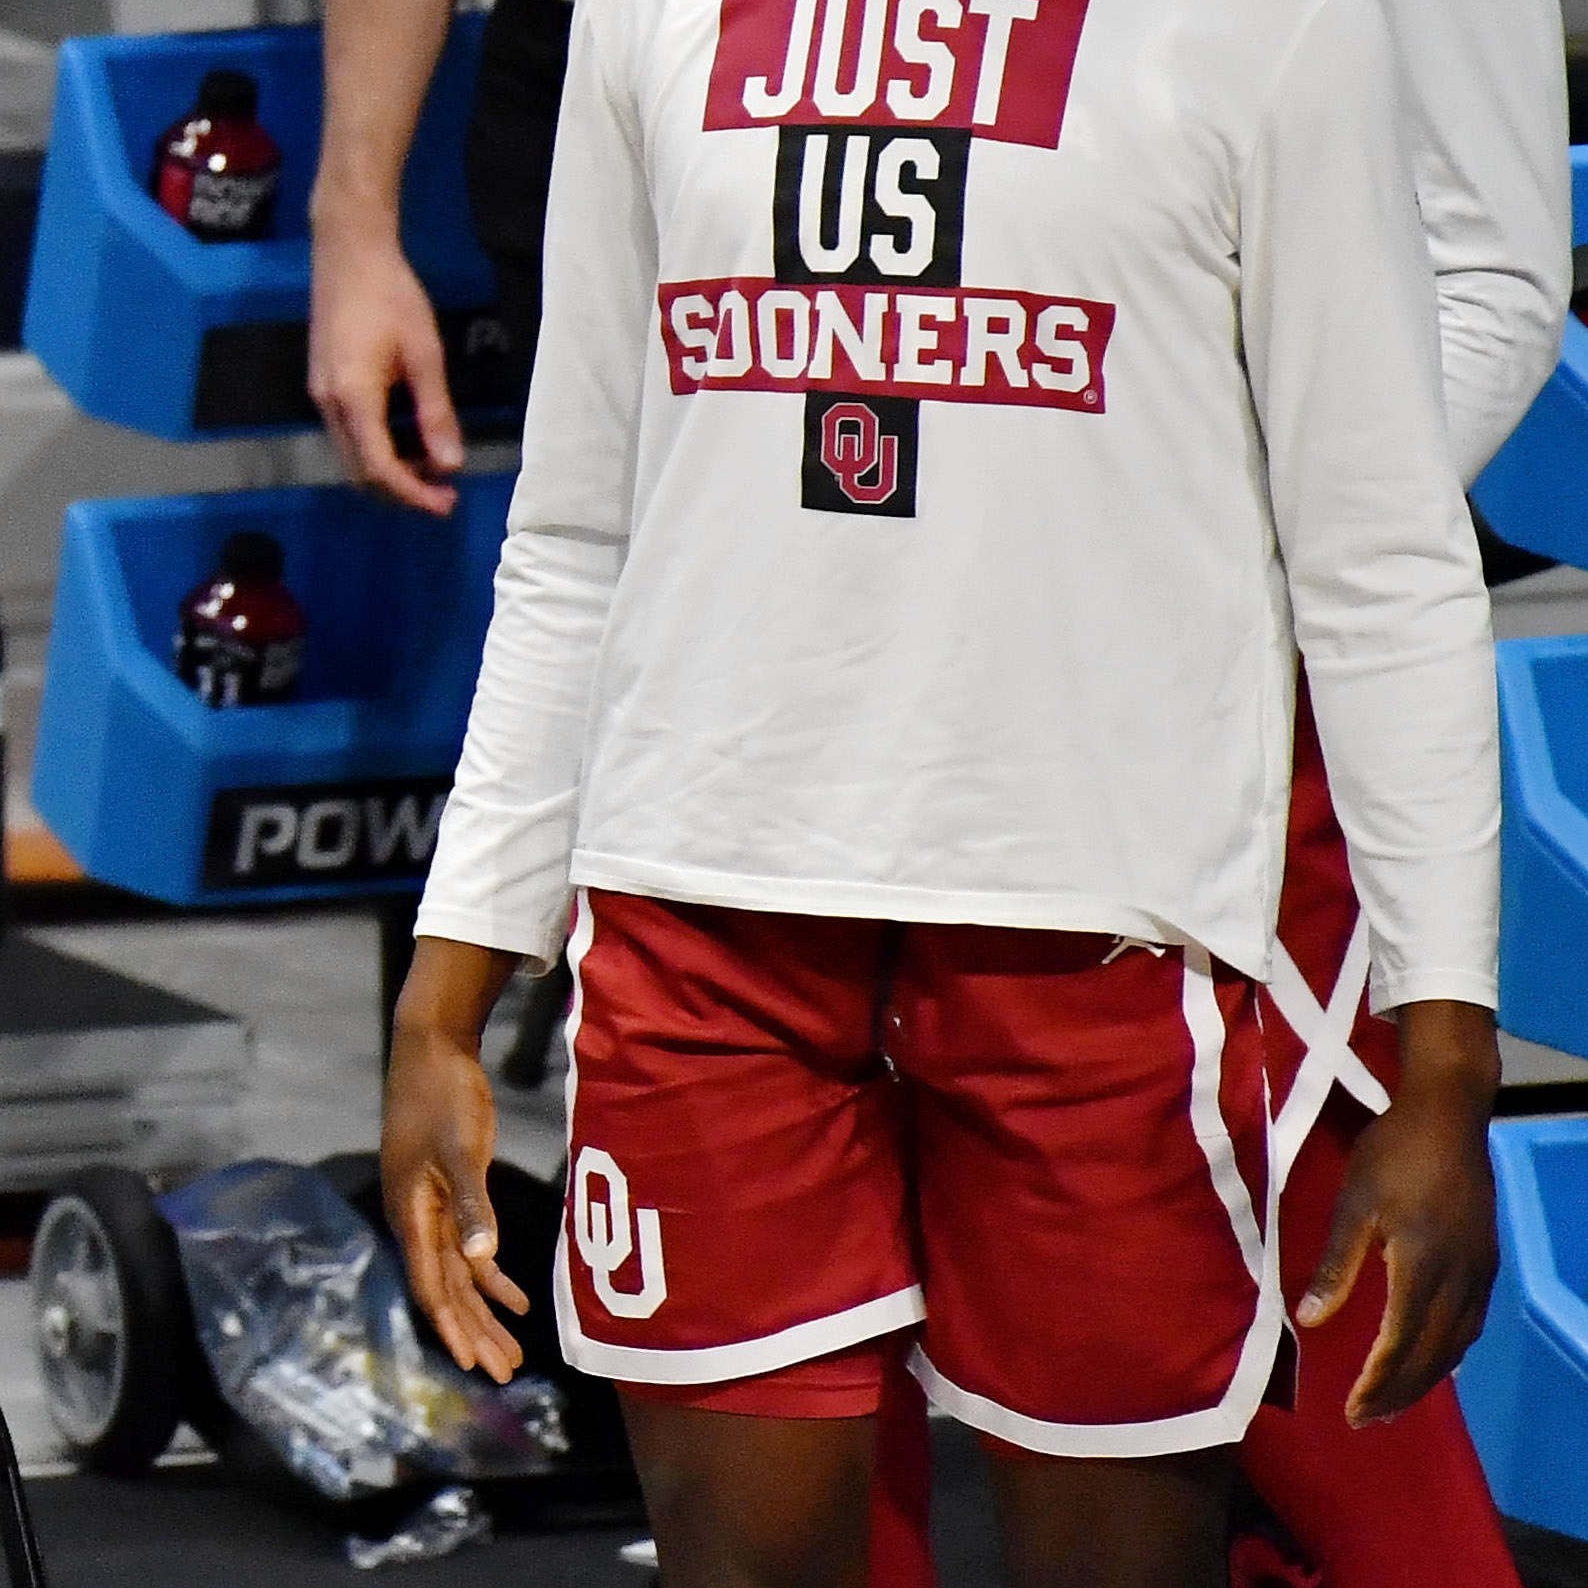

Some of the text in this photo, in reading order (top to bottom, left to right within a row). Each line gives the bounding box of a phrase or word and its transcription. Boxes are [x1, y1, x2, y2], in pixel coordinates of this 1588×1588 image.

[797, 134, 941, 277] US
[669, 289, 1092, 392] SOONERS
[820, 402, 899, 505] OU
[574, 1145, 669, 1320] OU
